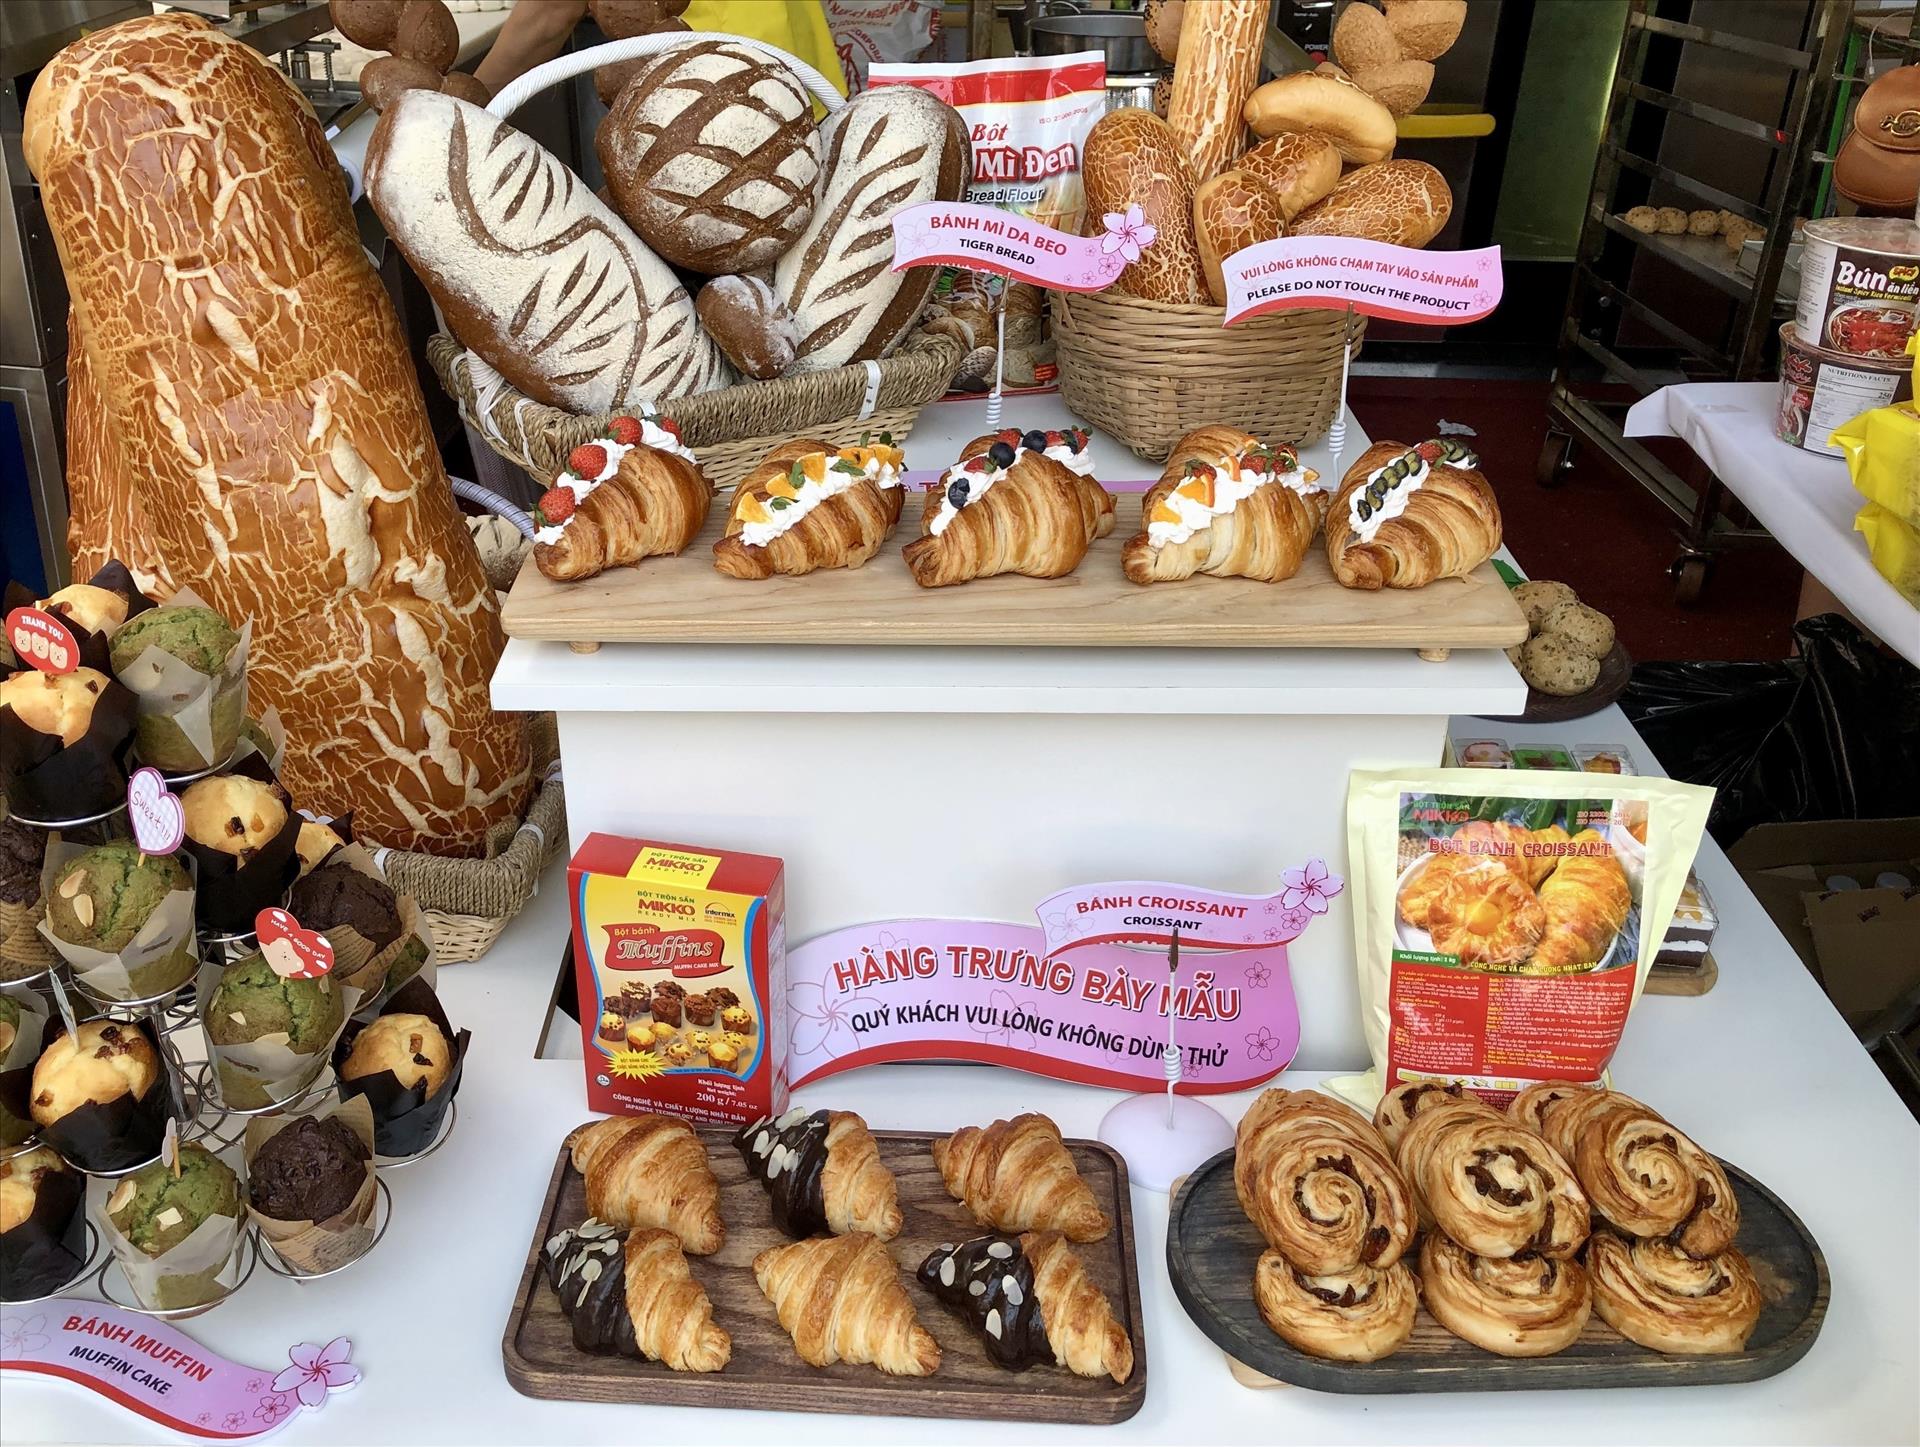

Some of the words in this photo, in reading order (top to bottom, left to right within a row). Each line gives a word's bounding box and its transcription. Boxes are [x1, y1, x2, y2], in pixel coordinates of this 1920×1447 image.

[971, 123, 1008, 145] Bột
[975, 147, 1018, 181] Mì
[1023, 143, 1077, 180] Đen
[966, 188, 1007, 201] Bread
[1008, 187, 1044, 200] Flour
[930, 213, 980, 231] BÁNH
[983, 219, 1004, 236] MÌ
[1006, 227, 1030, 245] DA
[1033, 236, 1068, 256] BEO
[959, 238, 994, 253] TIGER
[996, 246, 1036, 265] BREAD
[1241, 268, 1260, 281] VUI
[1262, 259, 1294, 274] LÒNG
[1296, 255, 1338, 268] KHÔNG
[1340, 257, 1373, 272] CHẠM
[1375, 262, 1396, 275] TAY
[1396, 264, 1420, 280] VÀO
[1420, 270, 1444, 285] SẢN
[1444, 274, 1479, 288] PHẨM
[1837, 261, 1888, 291] Bún
[1247, 283, 1292, 301] PLEASE
[1294, 280, 1313, 291] DO
[1316, 280, 1342, 289] NOT
[1344, 281, 1386, 296] TOUCH
[1388, 288, 1412, 301] THE
[1412, 293, 1470, 311] PRODUCT
[1887, 282, 1900, 294] ăn
[1828, 367, 1868, 380] NUTRITIONS
[21, 616, 48, 631] THANK
[48, 624, 64, 640] YOU
[1429, 836, 1463, 856] BỘT
[1522, 842, 1612, 858] CROISSANT
[643, 865, 676, 873] READY
[646, 858, 704, 872] MIKKO
[637, 890, 653, 898] BỘT
[638, 899, 696, 916] MIKKO
[638, 910, 670, 918] READY
[1076, 894, 1134, 914] BÁNH
[1137, 896, 1249, 919] CROISSANT
[614, 928, 629, 936] Bột
[632, 927, 656, 935] bánh
[1123, 916, 1203, 931] CROISSANT
[270, 919, 288, 932] HAVE
[293, 938, 311, 952] GOOD
[312, 950, 326, 959] DAY
[616, 935, 714, 965] Muffins
[832, 945, 938, 992] HÀNG
[946, 945, 1074, 996] TRƯNG
[1081, 964, 1155, 1012] BÀY
[1157, 970, 1242, 1022] MẪU
[851, 1004, 892, 1033] QUÝ
[896, 1000, 960, 1025] KHÁCH
[964, 1004, 998, 1026] VUI
[1002, 1006, 1055, 1038] LÒNG
[1056, 1021, 1126, 1053] KHÔNG
[1188, 1042, 1229, 1068] THỬ
[698, 1078, 713, 1086] Khối
[714, 1081, 732, 1090] lượng
[613, 1093, 632, 1103] CÔNG
[653, 1098, 663, 1108] VÀ
[664, 1102, 684, 1112] CHẤT
[685, 1106, 709, 1117] LƯỢNG
[731, 1113, 746, 1122] BẢN
[625, 1103, 654, 1113] JAPANESE
[655, 1108, 694, 1120] TECHNOLOGY
[696, 1092, 716, 1103] 200
[717, 1098, 724, 1106] g
[731, 1100, 748, 1108] 7.05
[62, 1315, 133, 1344] BÁNH
[130, 1334, 214, 1383] MUFFIN
[69, 1345, 132, 1376] MUFFIN
[130, 1368, 173, 1397] CAKE
